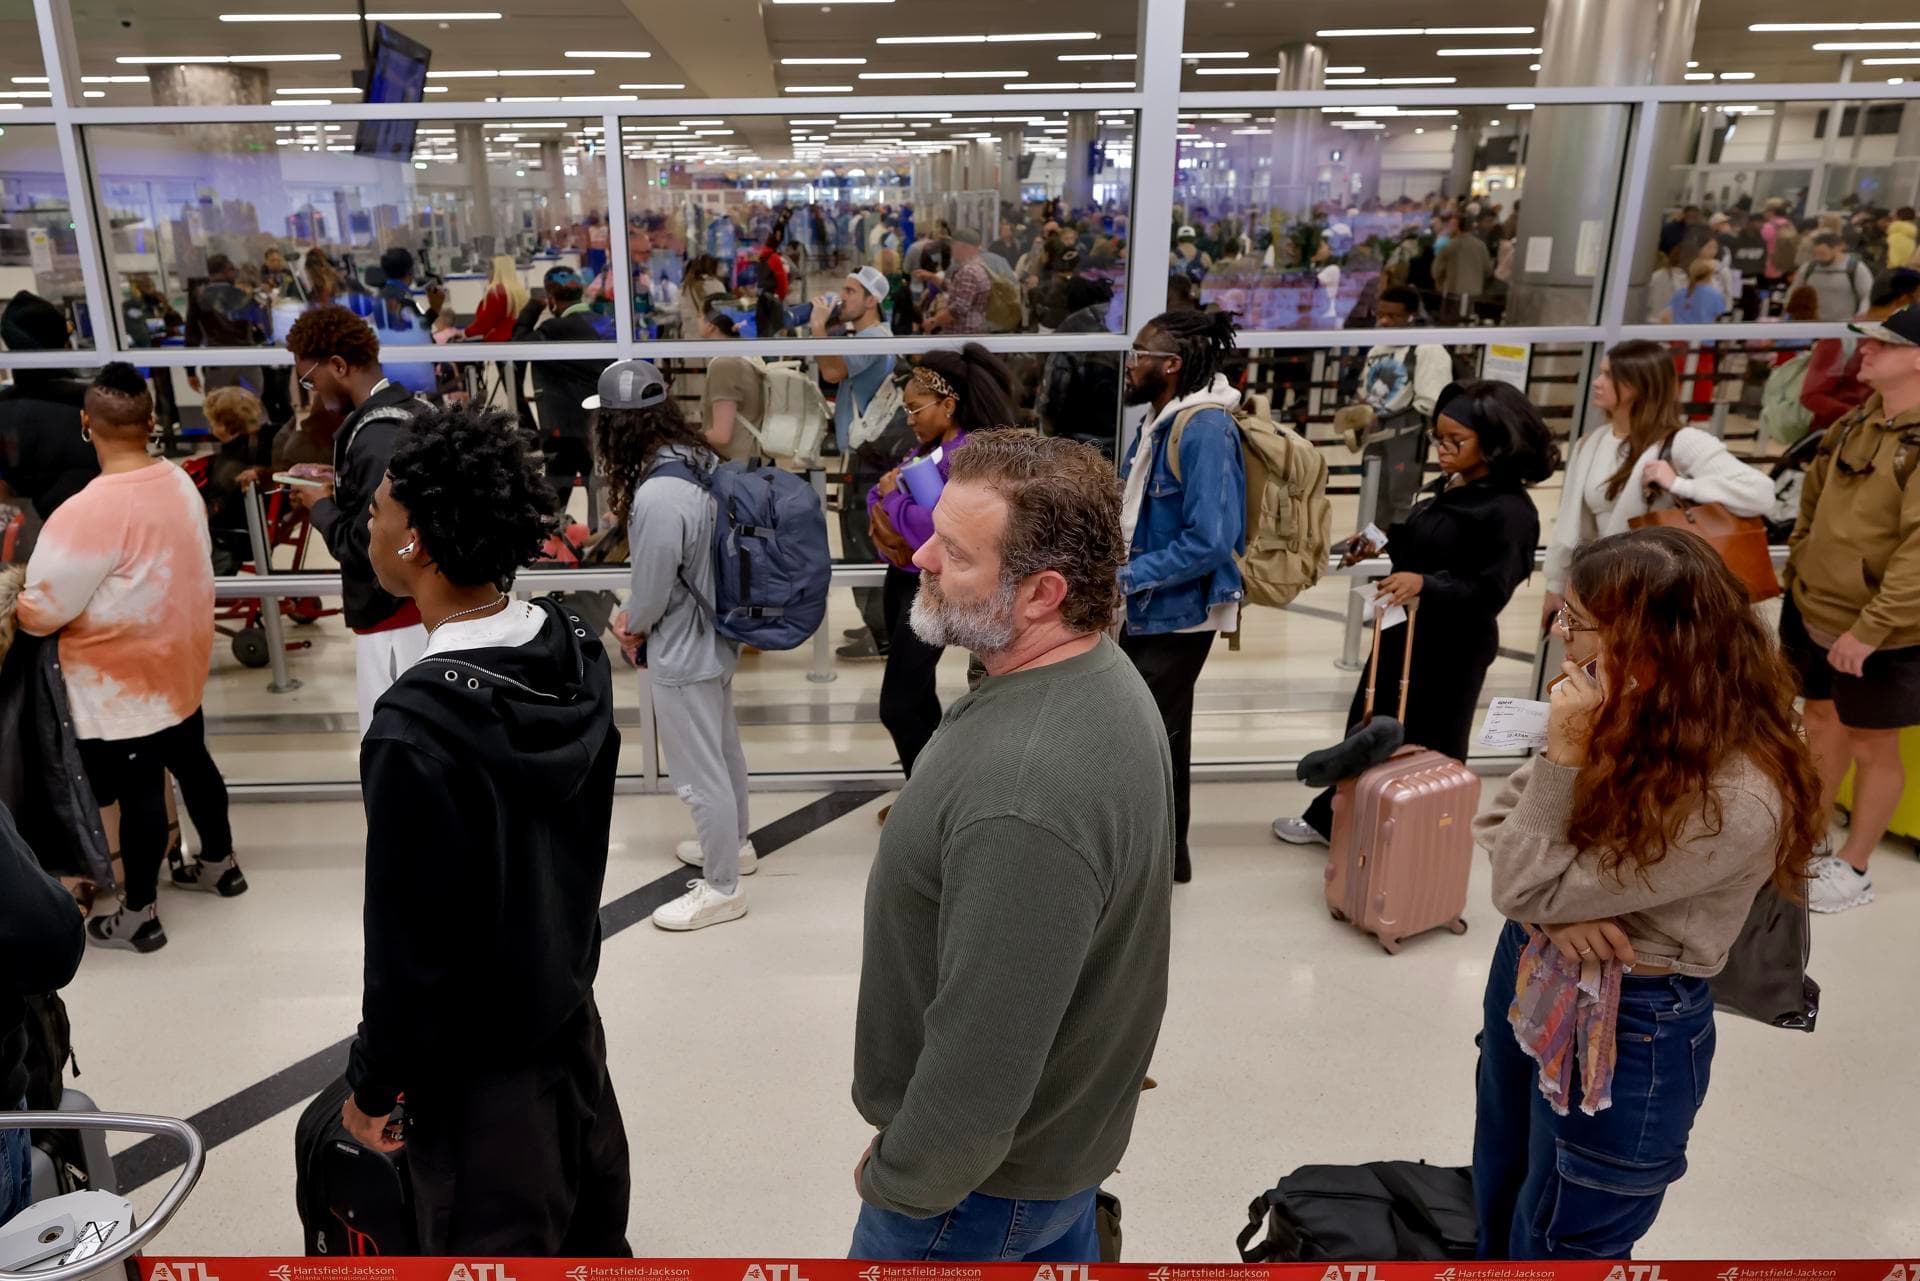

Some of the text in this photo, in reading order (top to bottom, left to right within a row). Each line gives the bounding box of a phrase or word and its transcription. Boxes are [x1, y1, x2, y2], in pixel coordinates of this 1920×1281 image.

[149, 1263, 220, 1281] ATL
[293, 1266, 395, 1275] Hartsfield-Jackson
[447, 1263, 517, 1281] ATL
[590, 1267, 690, 1276] Hartsfield-Jackson
[741, 1264, 810, 1281] ATL
[883, 1267, 982, 1276] Hartsfield-Jackson
[1033, 1264, 1099, 1281] ATL
[1172, 1268, 1270, 1278] Hartsfield-Jackson
[1320, 1265, 1386, 1281] ATL
[1458, 1269, 1555, 1278] Hartsfield-Jackson
[1602, 1265, 1668, 1281] ATL
[1741, 1269, 1837, 1277] Hartsfield-Jackson
[1881, 1264, 1920, 1281] AT
